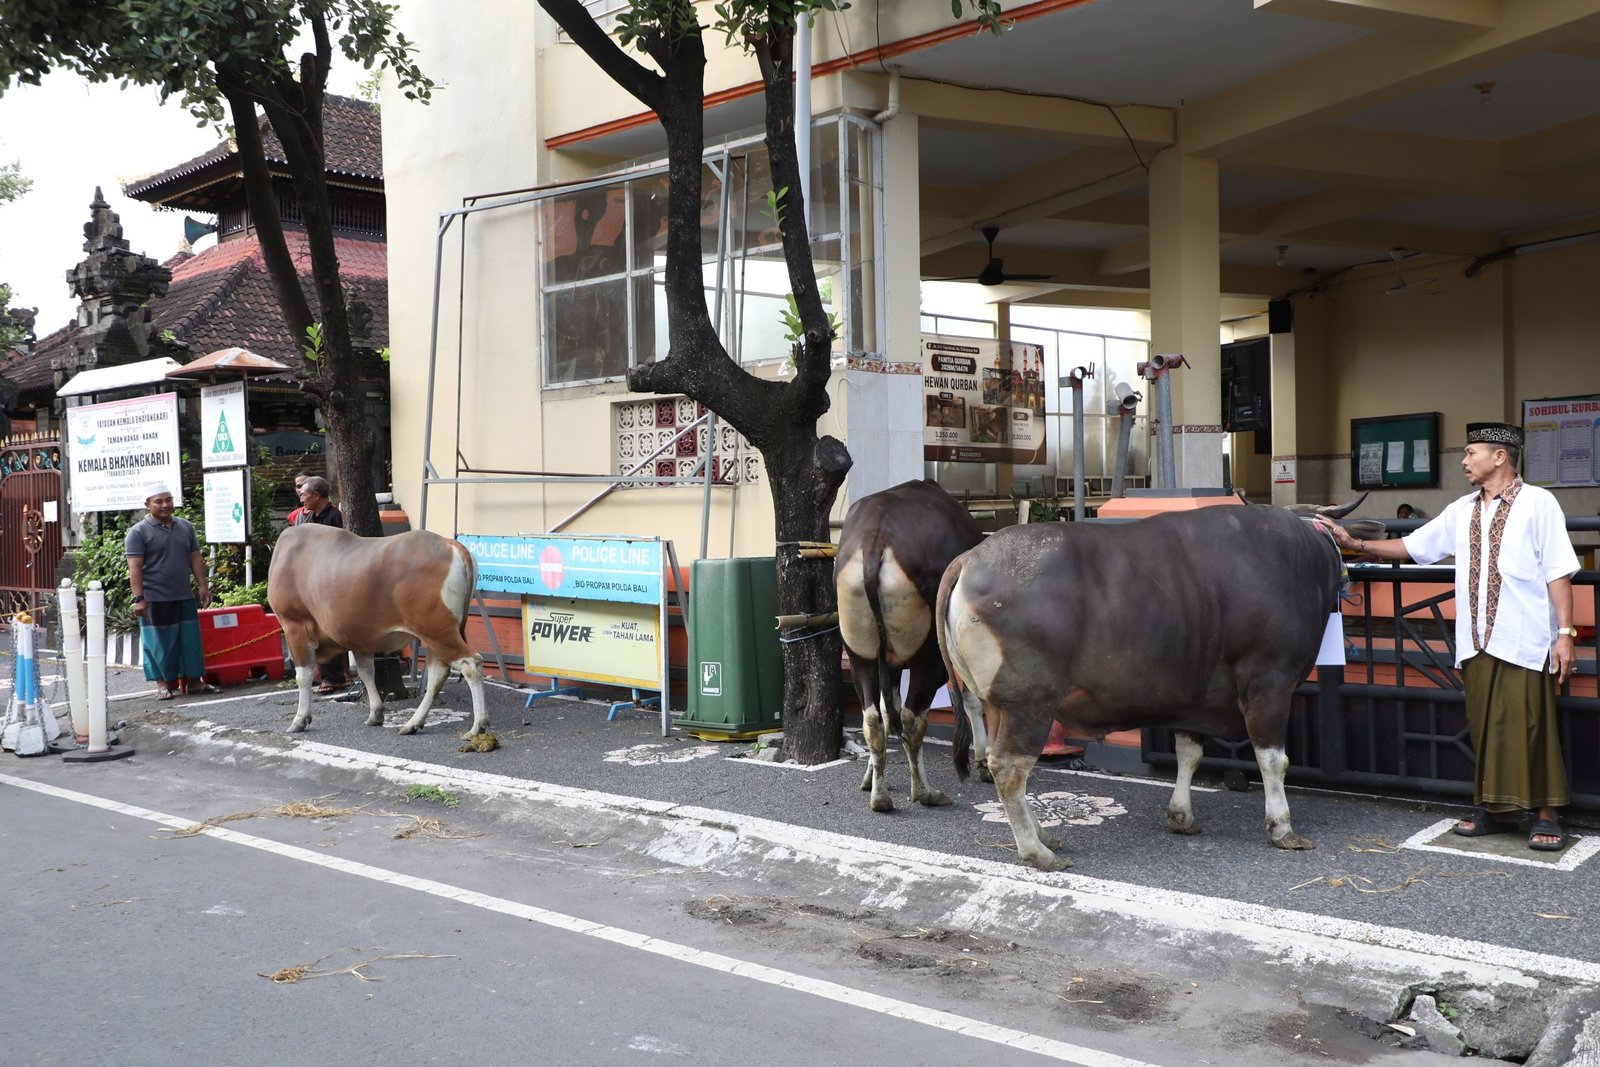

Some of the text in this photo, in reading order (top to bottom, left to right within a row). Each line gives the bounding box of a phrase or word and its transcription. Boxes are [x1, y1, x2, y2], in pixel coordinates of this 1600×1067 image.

[937, 356, 971, 366] PANITIA QURBAN
[924, 376, 978, 391] HEWAN QURBAN
[1529, 402, 1600, 417] SOHIBUL KURB
[97, 411, 169, 428] YAYASAN KEMALA BHAYANGKARI
[107, 435, 122, 445] TAMAN
[124, 433, 139, 443] KANAK
[143, 431, 158, 440] KANAK
[78, 457, 108, 473] KEMALA
[109, 452, 165, 470] BHAYANGKARI
[470, 542, 536, 560] POLICE LINE
[572, 545, 650, 565] POLICE LINE
[482, 574, 504, 583] PROPAM
[504, 576, 522, 584] POLDA
[522, 577, 535, 585] BALI
[575, 580, 648, 593] BID PROPAM POLDA BALI
[534, 612, 574, 625] Super
[531, 621, 597, 645] POWER
[621, 622, 638, 632] KUAT,
[612, 630, 634, 641] TAHAN
[635, 633, 654, 643] LAMA
